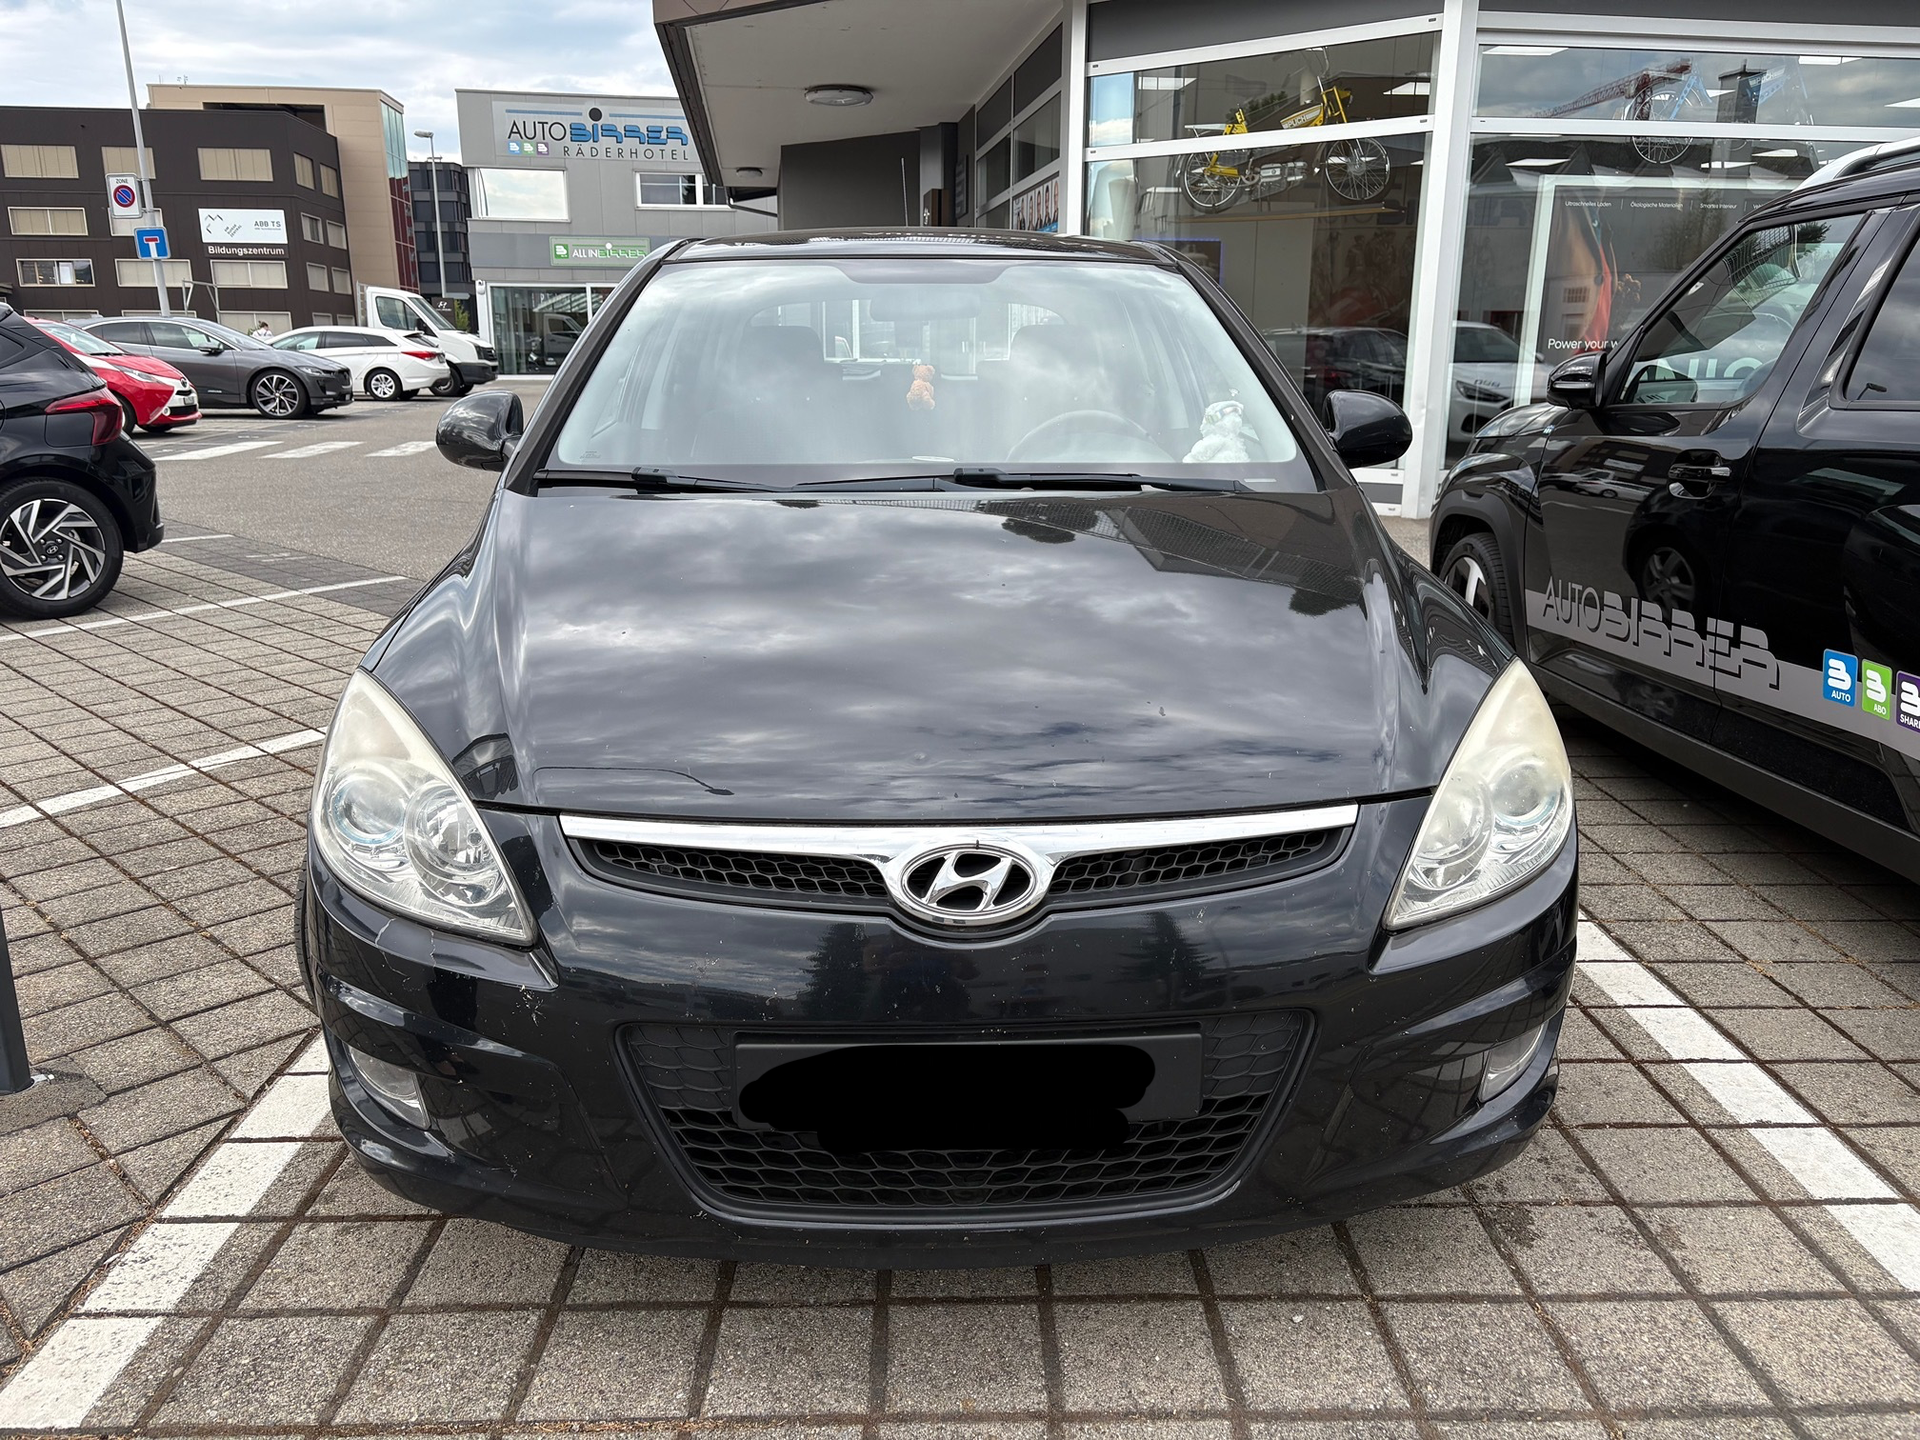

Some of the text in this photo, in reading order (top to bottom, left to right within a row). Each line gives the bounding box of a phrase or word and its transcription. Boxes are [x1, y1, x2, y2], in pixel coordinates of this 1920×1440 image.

[563, 144, 689, 160] RÄDERHOTEL
[208, 245, 285, 256] Bildungszentrum
[572, 249, 587, 258] ALL
[1548, 338, 1582, 350] Power
[1585, 341, 1608, 351] your
[1831, 690, 1851, 702] AUTO
[1873, 703, 1886, 715] ABO
